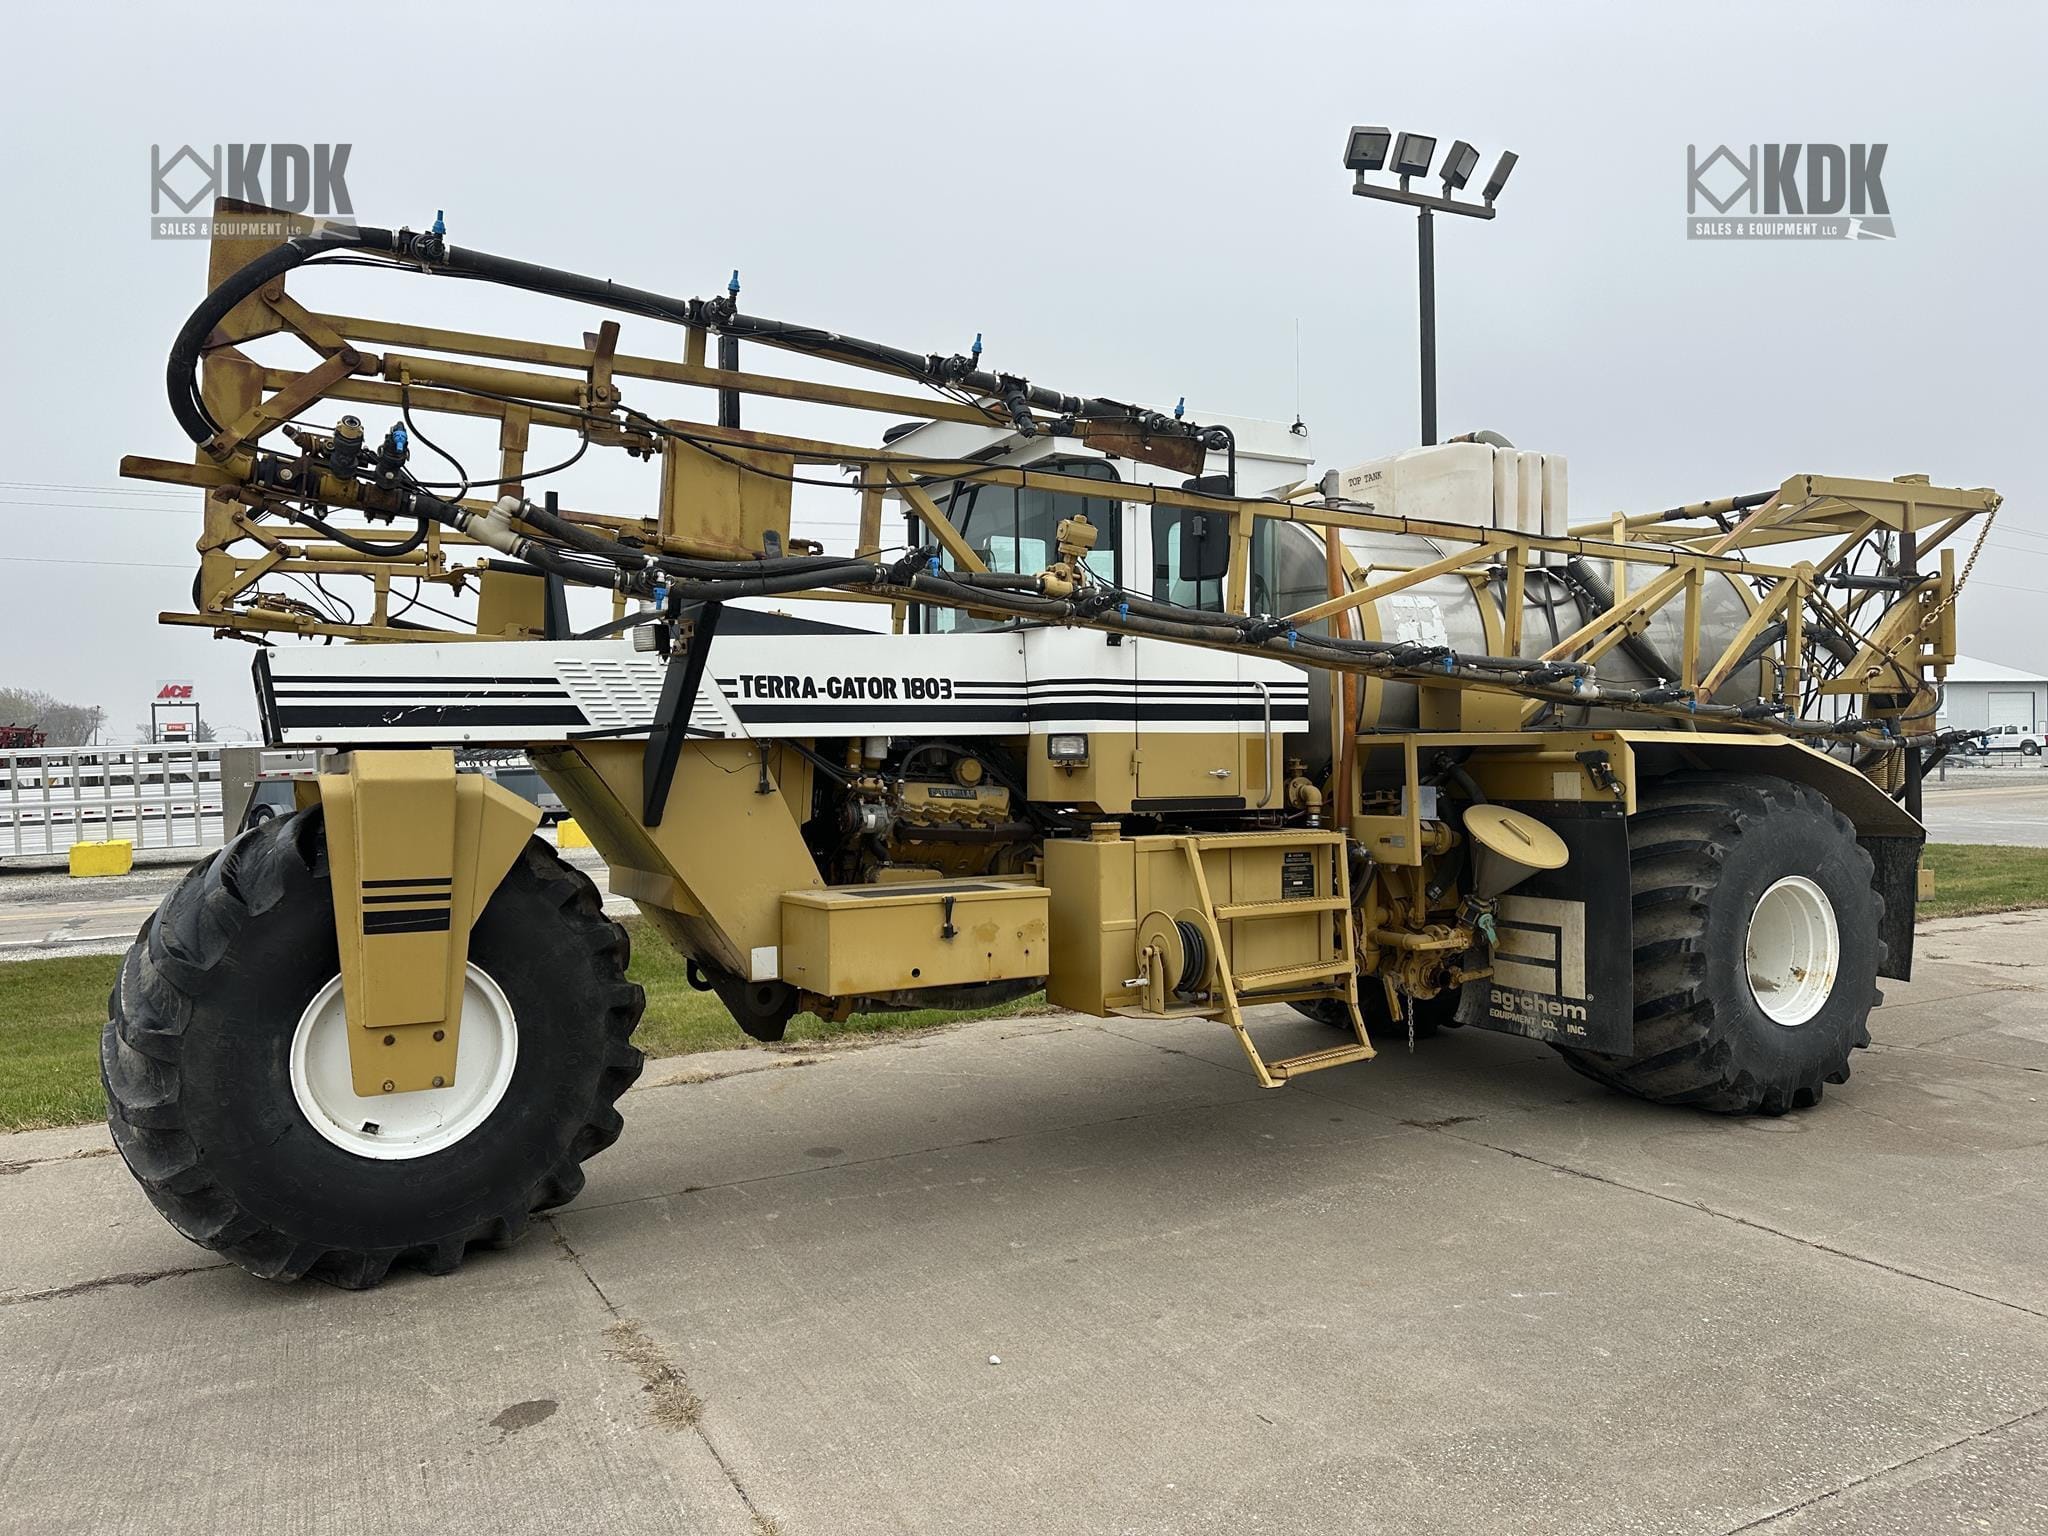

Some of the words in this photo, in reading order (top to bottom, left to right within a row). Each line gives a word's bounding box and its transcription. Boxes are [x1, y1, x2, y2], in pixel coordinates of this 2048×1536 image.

[1347, 476, 1361, 487] TOP
[1364, 471, 1382, 483] TANK
[157, 684, 193, 698] ACE
[739, 674, 898, 700] TERRA-GATOR
[902, 677, 952, 700] 1803
[1489, 1008, 1537, 1025] EQUIPMENT
[1566, 1023, 1587, 1036] INC.
